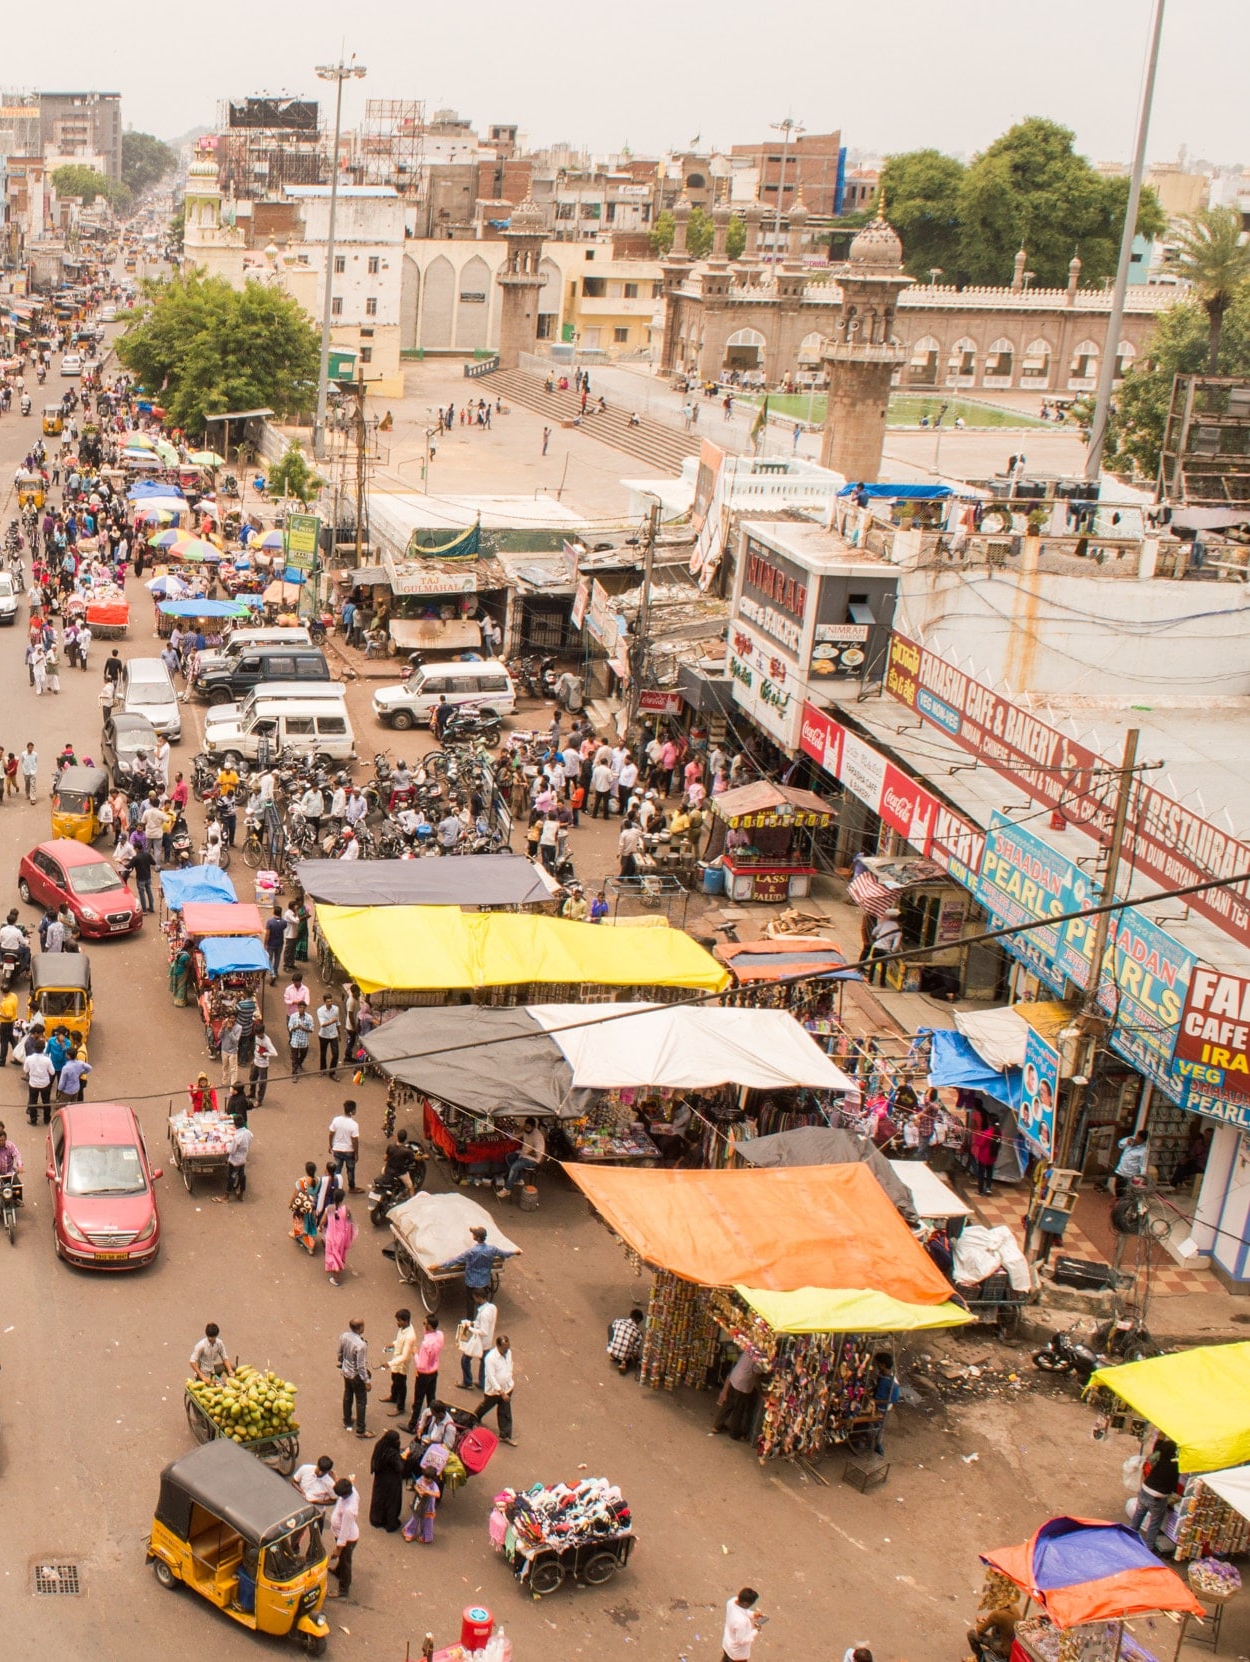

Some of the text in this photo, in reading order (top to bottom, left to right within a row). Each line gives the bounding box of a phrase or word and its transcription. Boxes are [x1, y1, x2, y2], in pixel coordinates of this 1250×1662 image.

[403, 583, 461, 594] GULMAHAL
[420, 577, 440, 585] TAJ
[828, 626, 866, 634] NIMRAH
[918, 651, 966, 710] FARASHA
[965, 681, 996, 731] CAFE
[993, 705, 1004, 737] &
[1004, 706, 1060, 769] BAKERY
[756, 874, 789, 883] LASSI
[949, 857, 967, 881] NON
[995, 835, 1063, 898] SHAADAN
[983, 850, 1065, 929] PEARLS
[1147, 842, 1165, 873] DUM
[1206, 886, 1232, 919] IRANI
[1231, 903, 1250, 931] TEA
[1184, 1012, 1249, 1050] CAFE
[1178, 1060, 1221, 1084] VEG
